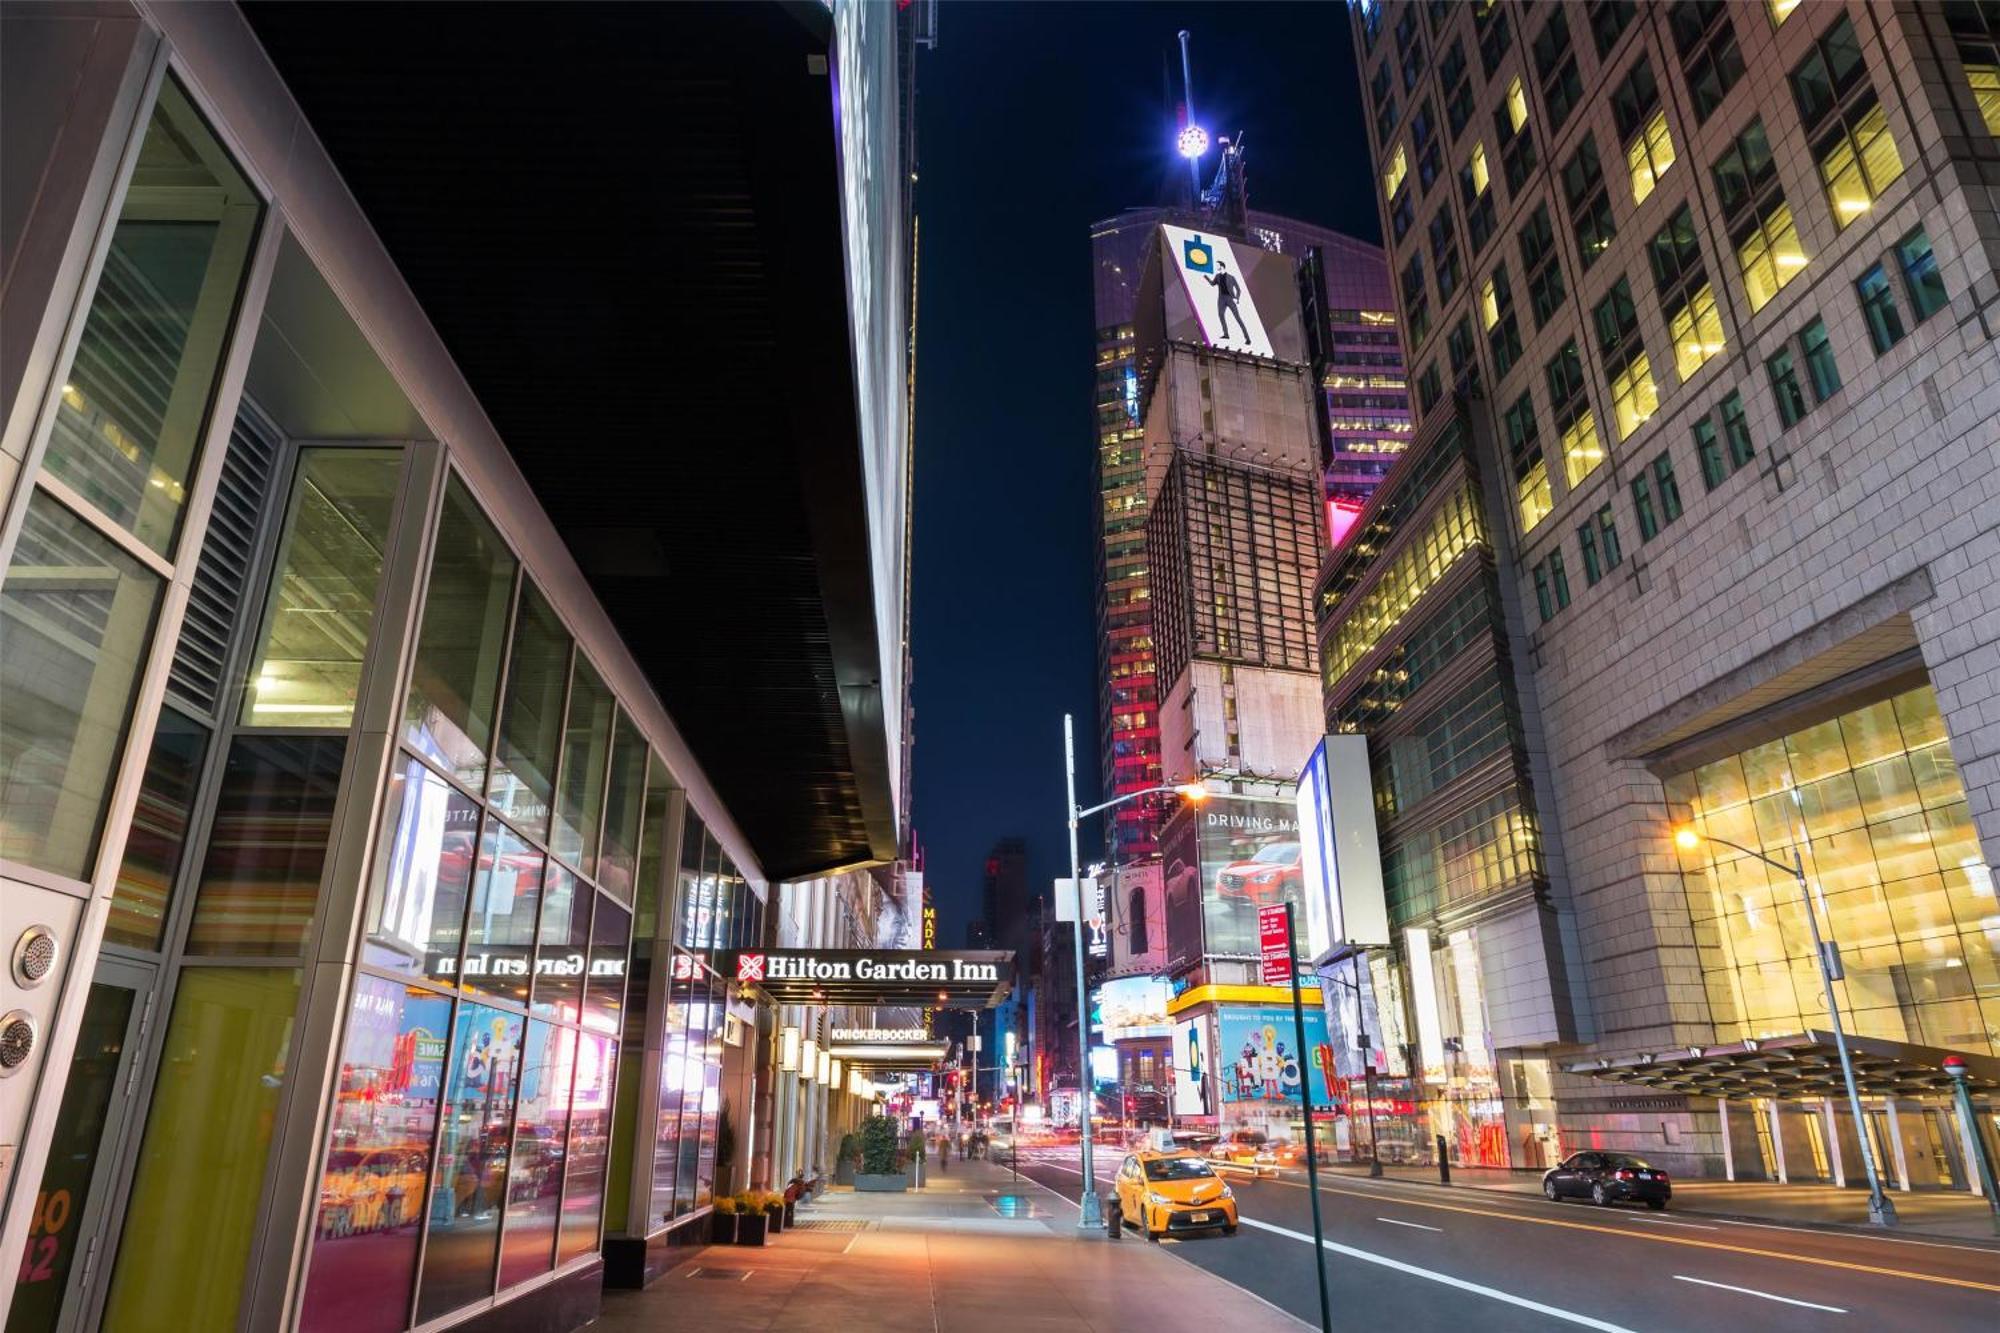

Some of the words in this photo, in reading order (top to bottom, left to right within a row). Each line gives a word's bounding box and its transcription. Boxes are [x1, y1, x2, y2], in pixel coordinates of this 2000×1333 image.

[1207, 812, 1273, 831] DRIVING
[1279, 818, 1299, 832] MA
[767, 956, 852, 979] Hilton
[855, 958, 948, 980] Garden
[952, 959, 999, 981] Inn
[831, 1028, 928, 1041] KNICKERBOCKER
